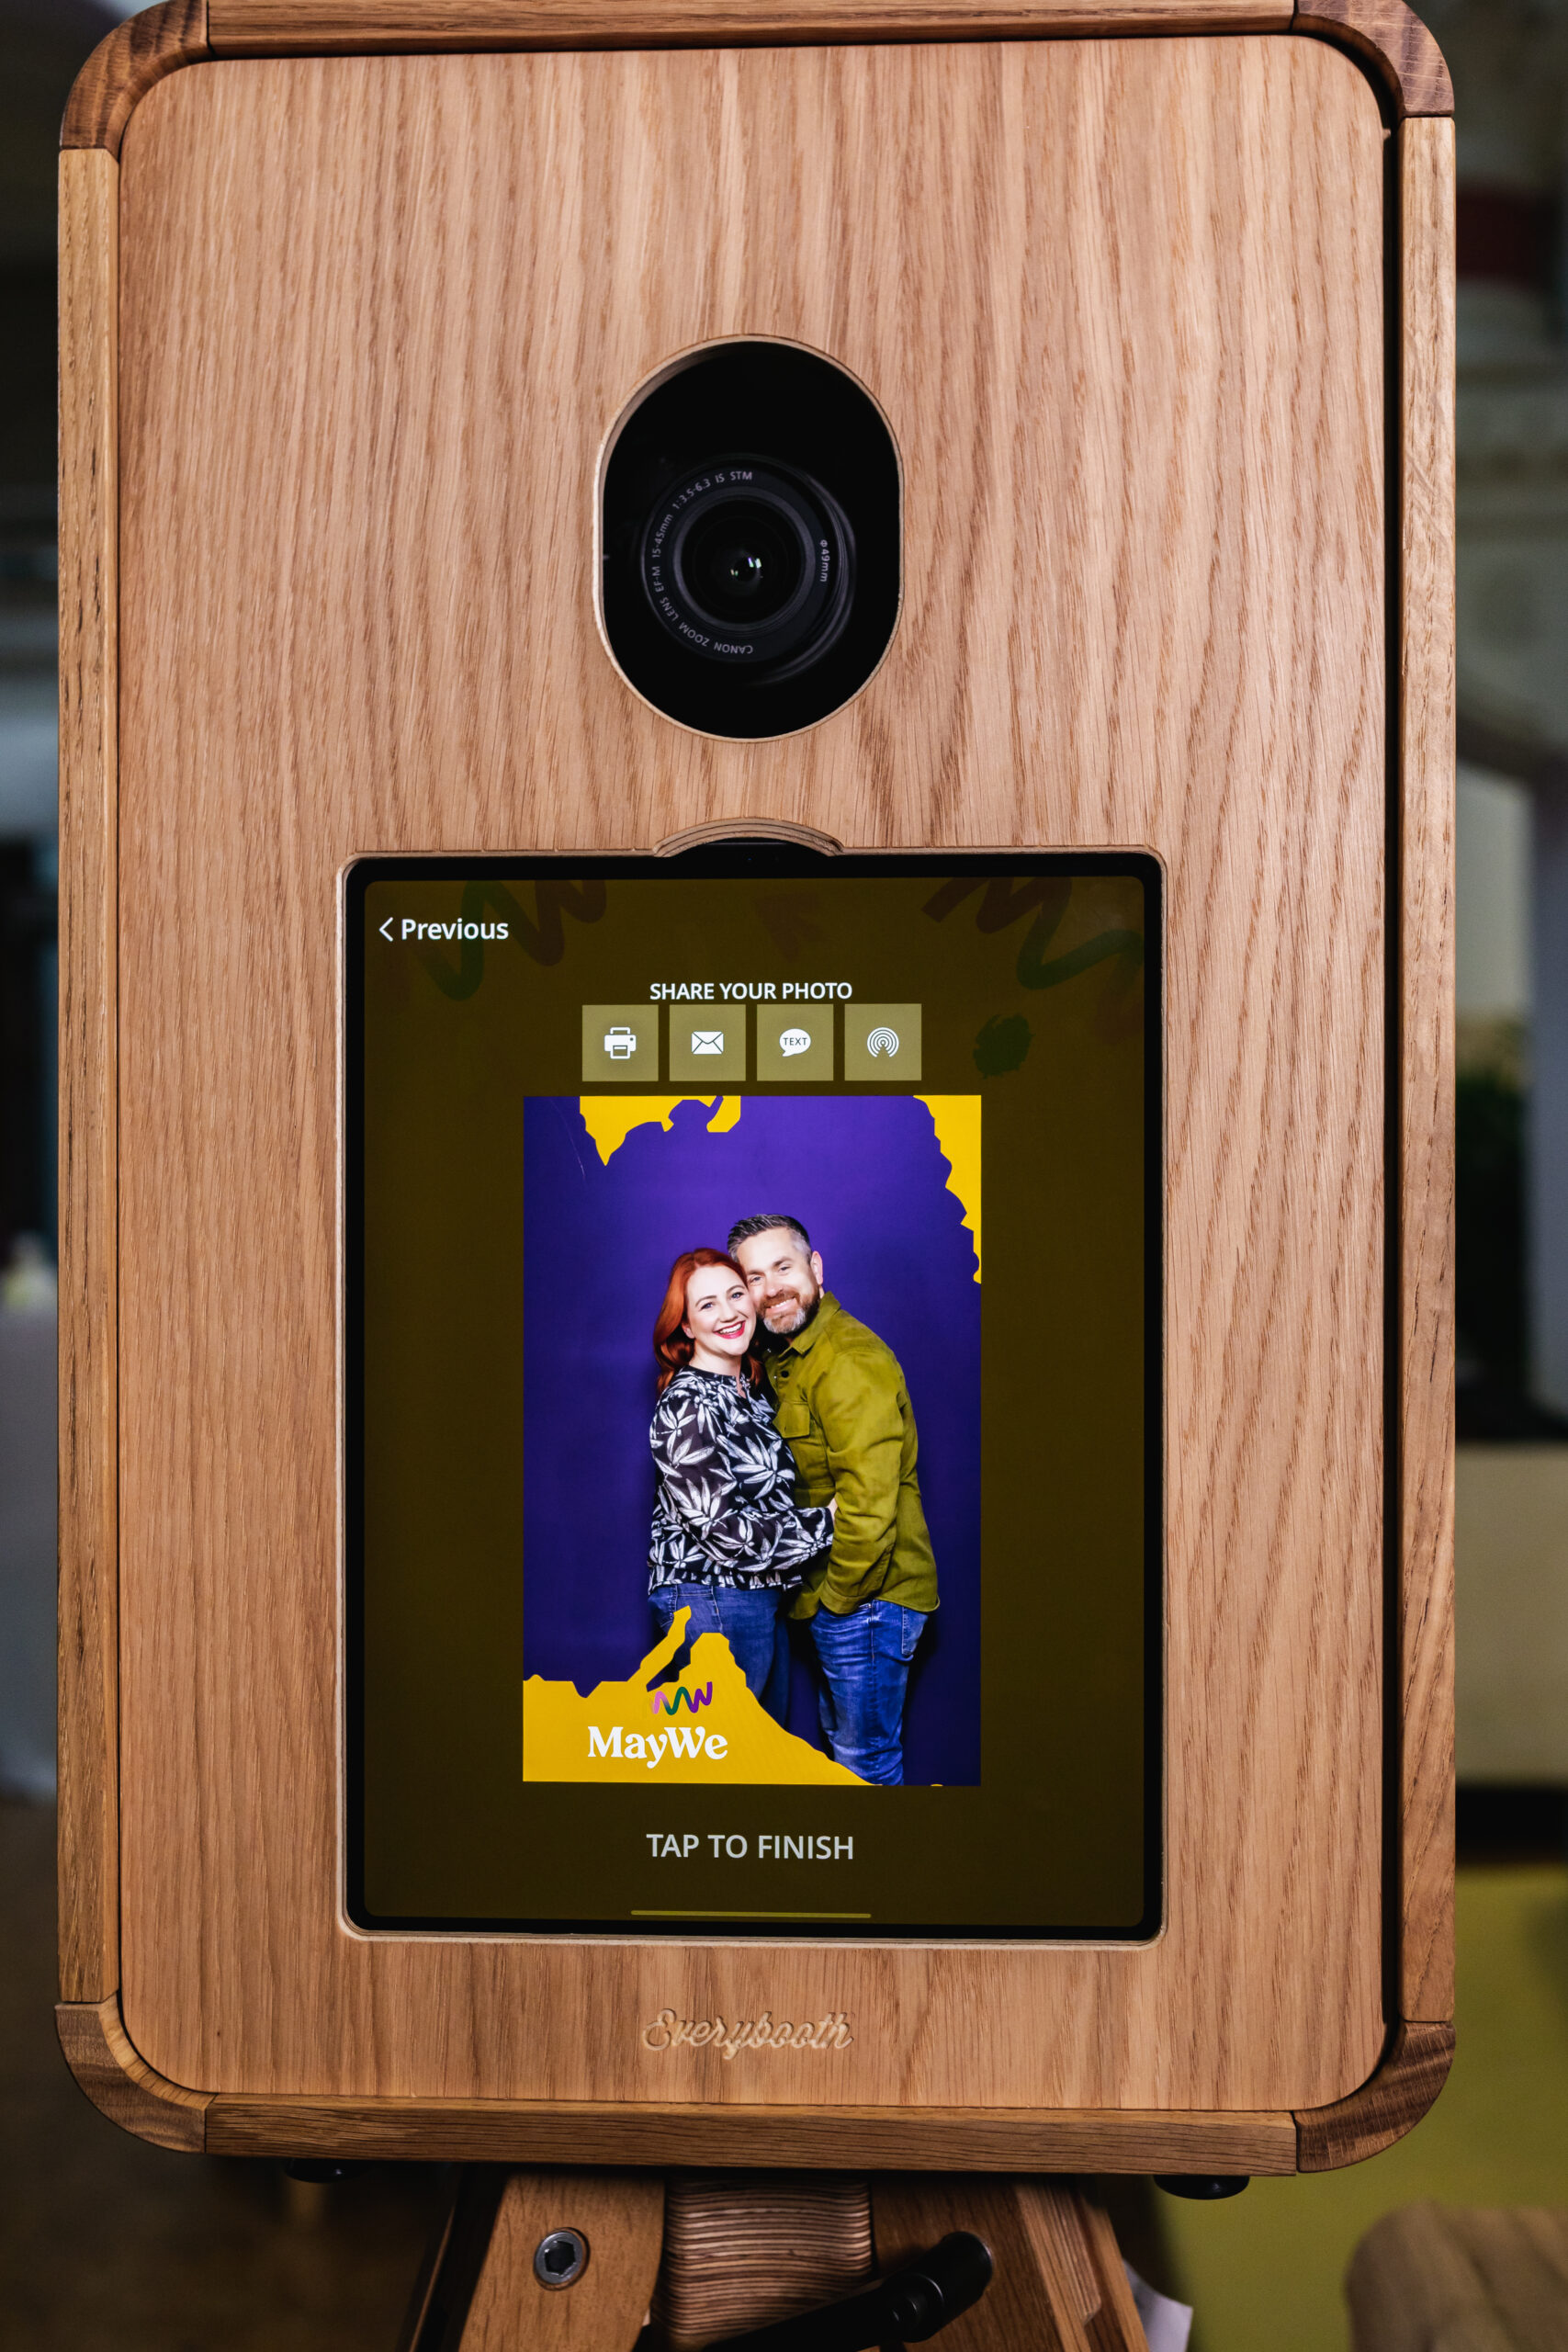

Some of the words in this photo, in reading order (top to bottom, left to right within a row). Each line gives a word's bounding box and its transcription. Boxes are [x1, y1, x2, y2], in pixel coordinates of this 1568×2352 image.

[715, 473, 725, 483] IS
[730, 471, 752, 481] STM
[672, 479, 711, 509] 1:3.5-6.3
[651, 514, 673, 558] 15-45mm
[651, 566, 664, 593] EF-M
[660, 597, 680, 621] LENS
[679, 622, 710, 647] ZOOM
[714, 642, 753, 654] CANON
[401, 918, 509, 940] Previous
[649, 983, 715, 1000] SHARE
[719, 983, 777, 1000] YOUR
[783, 982, 852, 999] PHOTO
[783, 1037, 807, 1046] TEXT
[587, 1725, 728, 1769] MayWe
[646, 1834, 699, 1858] TAP
[707, 1834, 748, 1859] TO
[758, 1835, 853, 1860] FINISH
[642, 2008, 853, 2059] Everybooth
